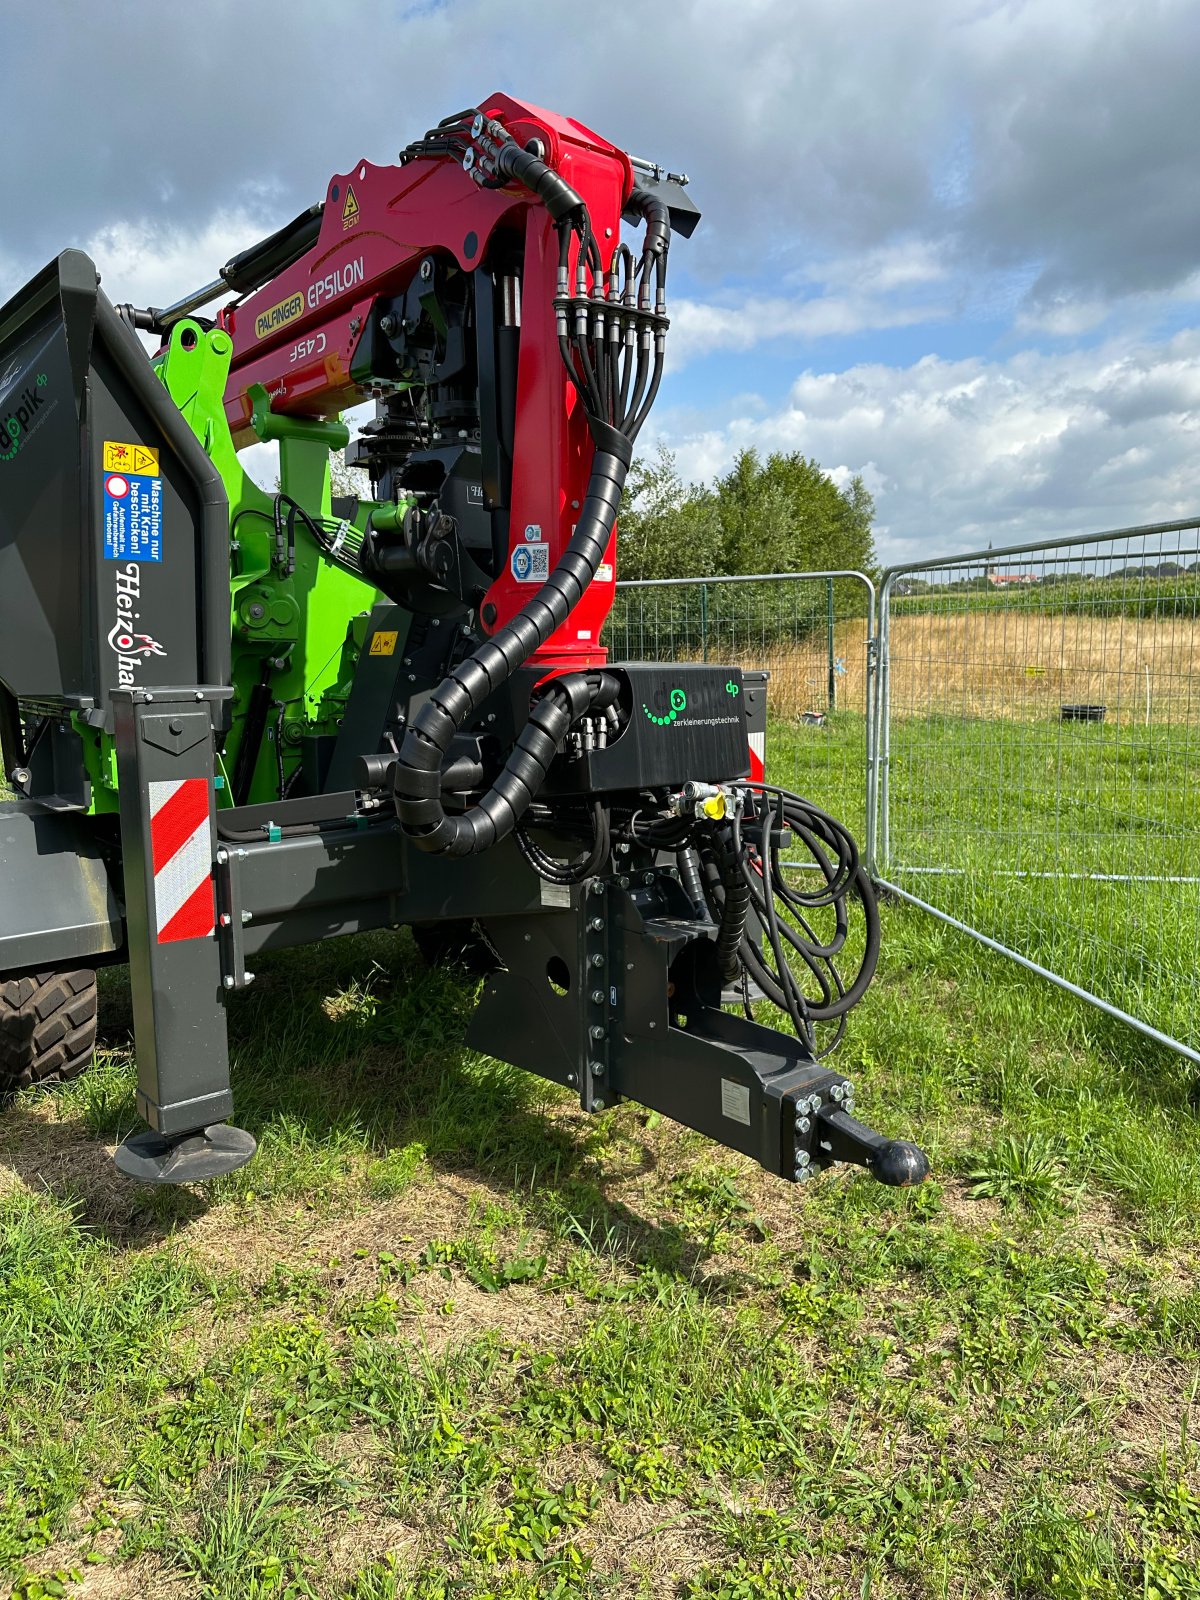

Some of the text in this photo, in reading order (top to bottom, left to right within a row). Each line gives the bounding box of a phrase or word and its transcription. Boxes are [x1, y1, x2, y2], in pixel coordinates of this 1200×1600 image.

[258, 256, 364, 335] PALFINGER EPSILON
[290, 332, 327, 363] C45F
[130, 482, 141, 554] beschicken!
[141, 494, 151, 544] mit Kran
[151, 480, 161, 560] Maschine nur
[119, 544, 125, 553] im
[725, 680, 739, 697] dp
[673, 715, 740, 727] zerkleinerungstechnik
